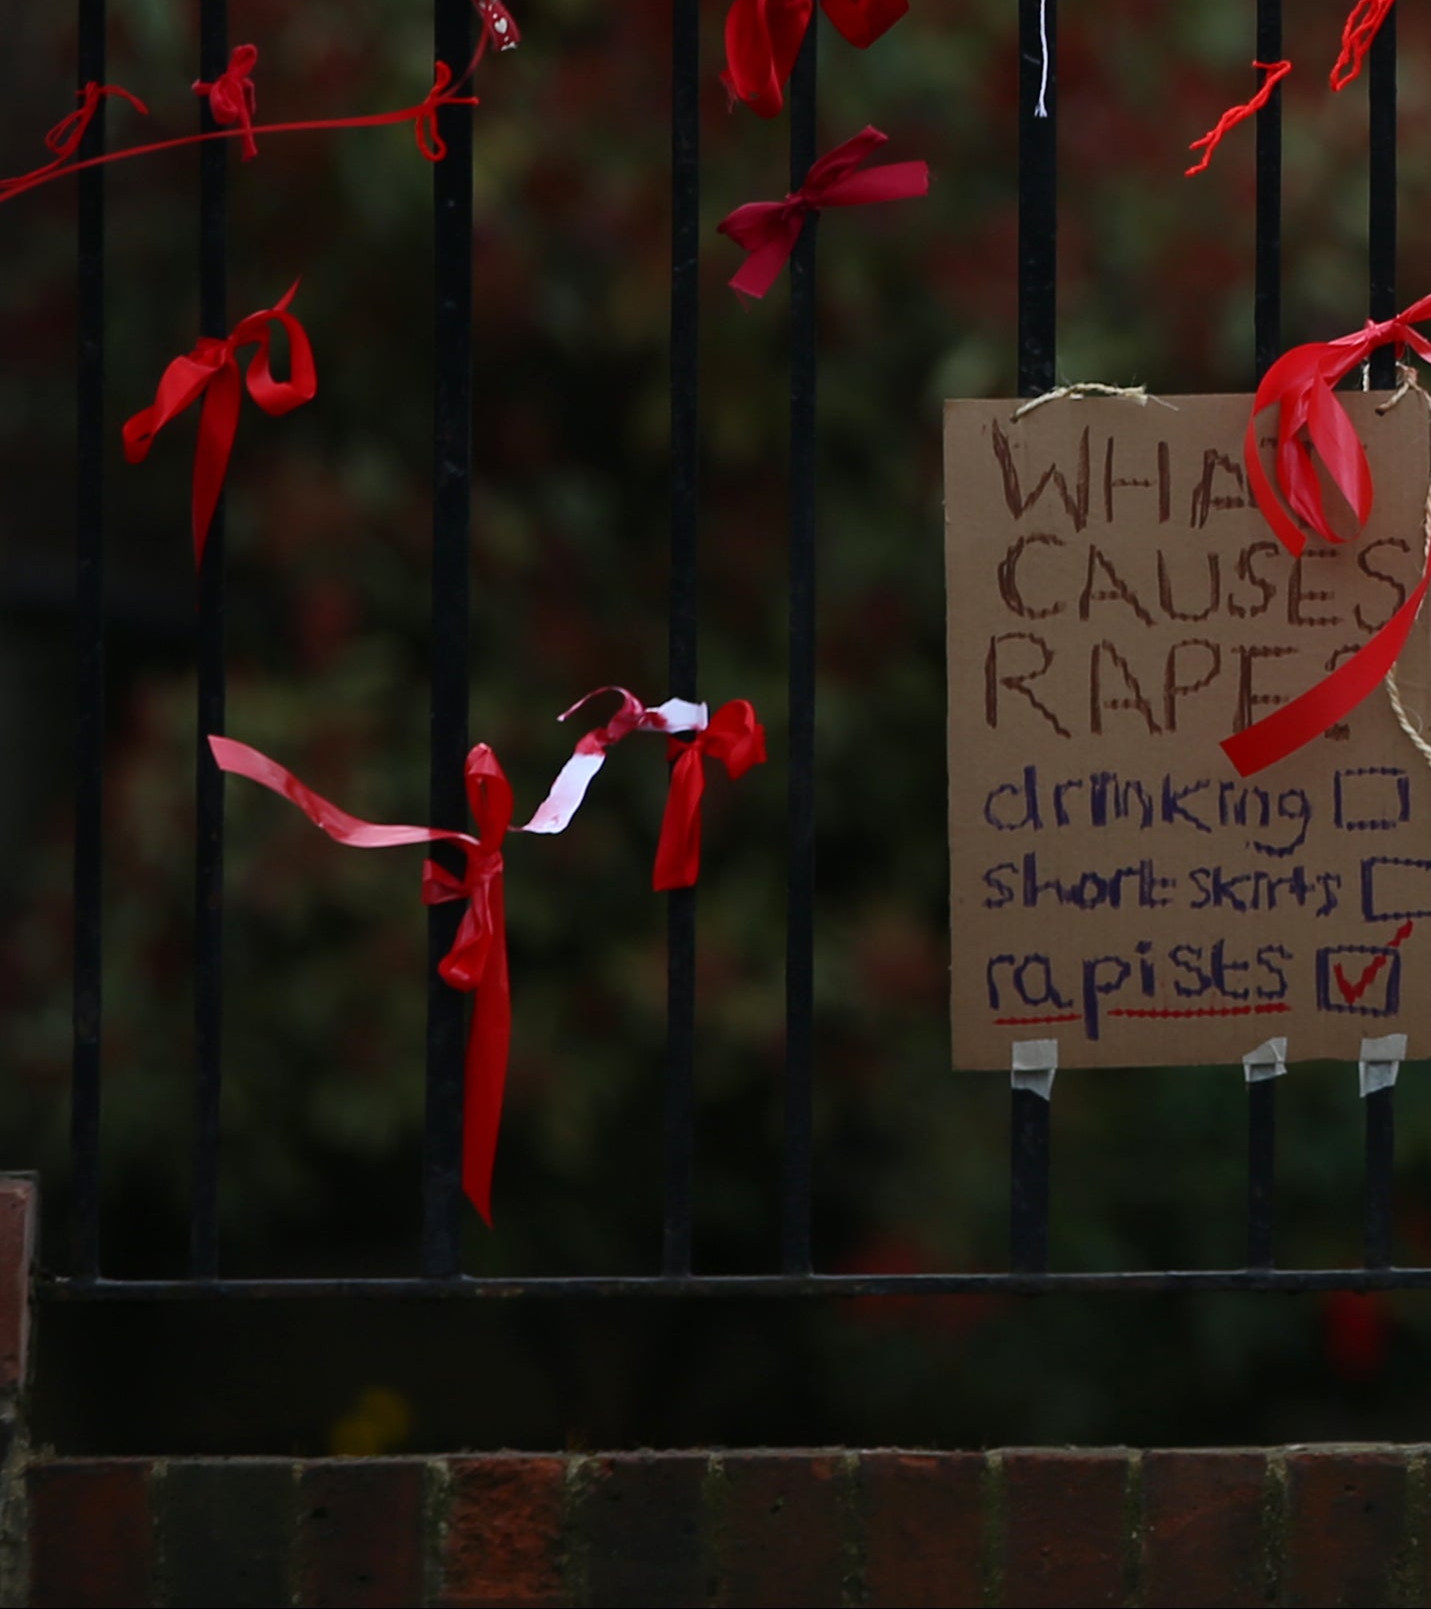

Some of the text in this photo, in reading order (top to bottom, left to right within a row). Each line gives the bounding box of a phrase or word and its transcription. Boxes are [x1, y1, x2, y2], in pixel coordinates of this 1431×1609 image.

[998, 533, 1411, 635] CAUSES
[983, 765, 1312, 857] drinking
[982, 851, 1342, 917] short skirts
[986, 938, 1293, 1041] rapists
